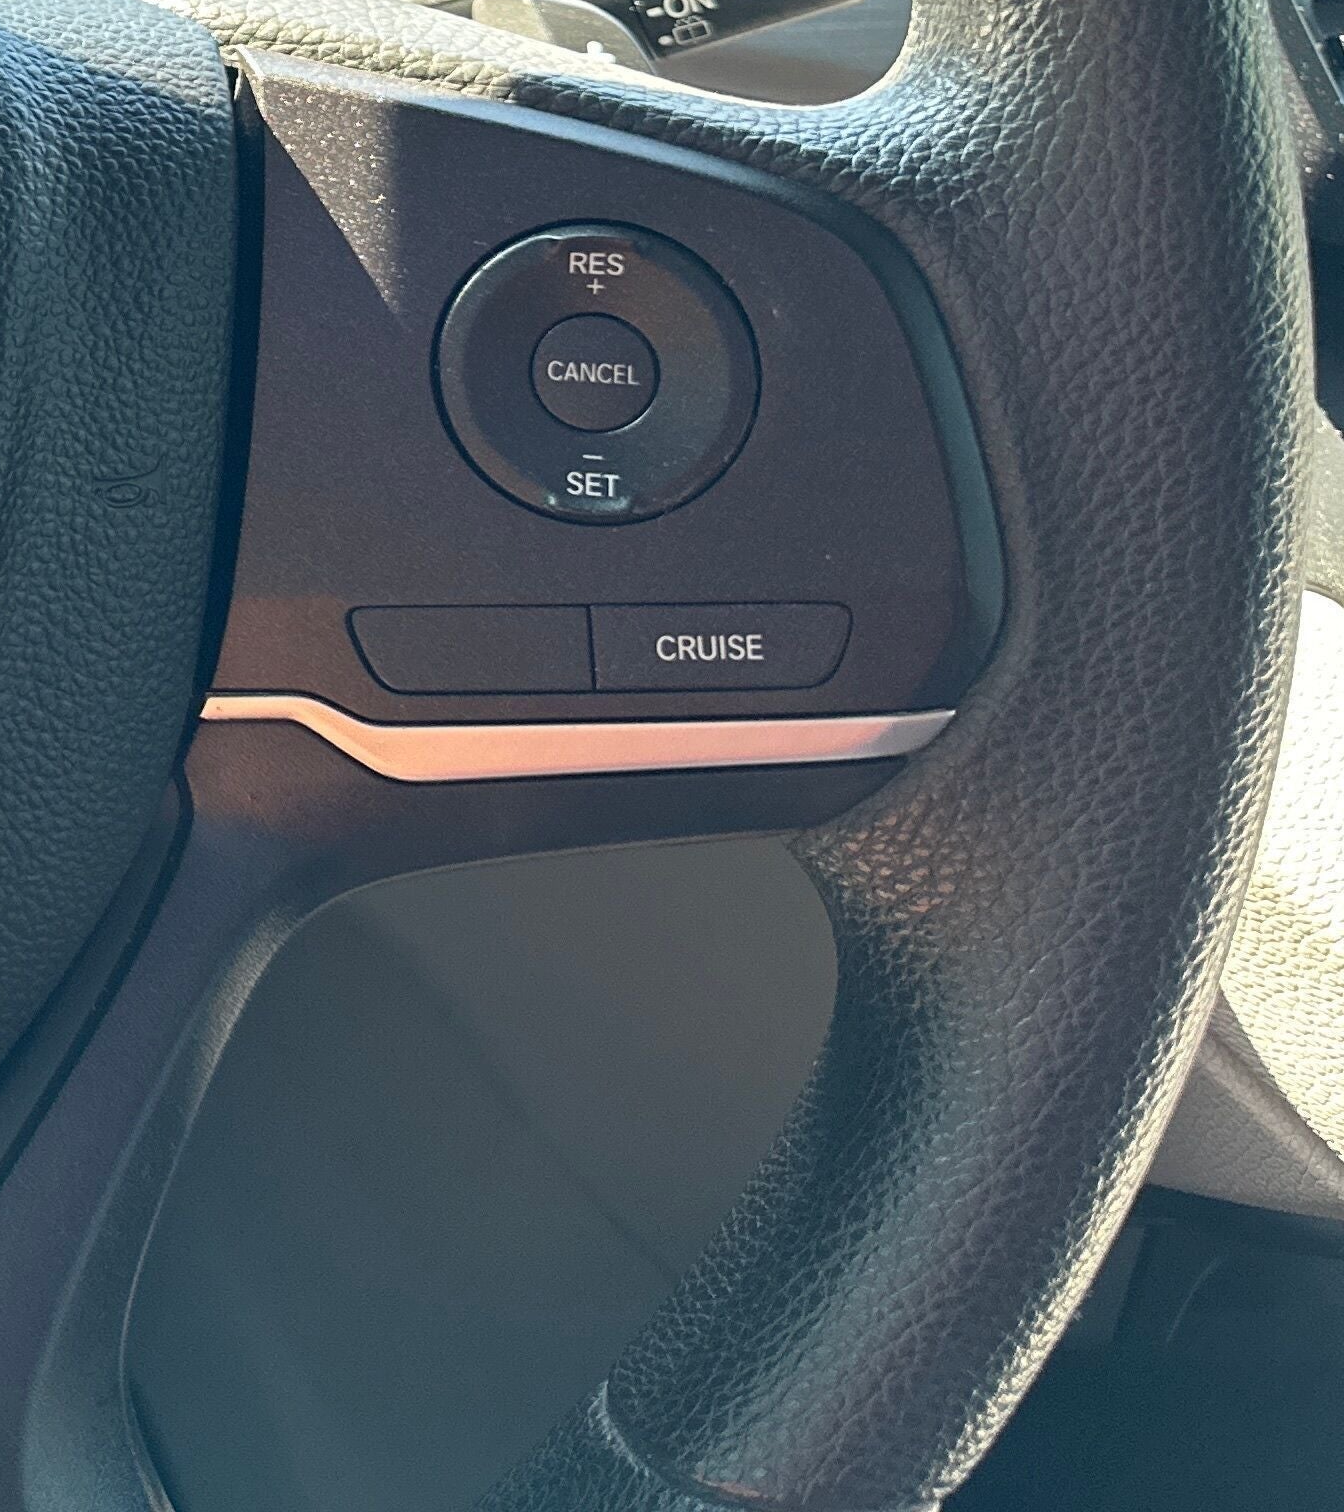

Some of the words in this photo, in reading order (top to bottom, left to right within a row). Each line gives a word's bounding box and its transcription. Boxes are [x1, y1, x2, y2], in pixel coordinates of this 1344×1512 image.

[568, 251, 625, 277] RES
[546, 358, 641, 388] CANCEL
[565, 471, 620, 499] SET
[655, 634, 765, 662] CRUISE
